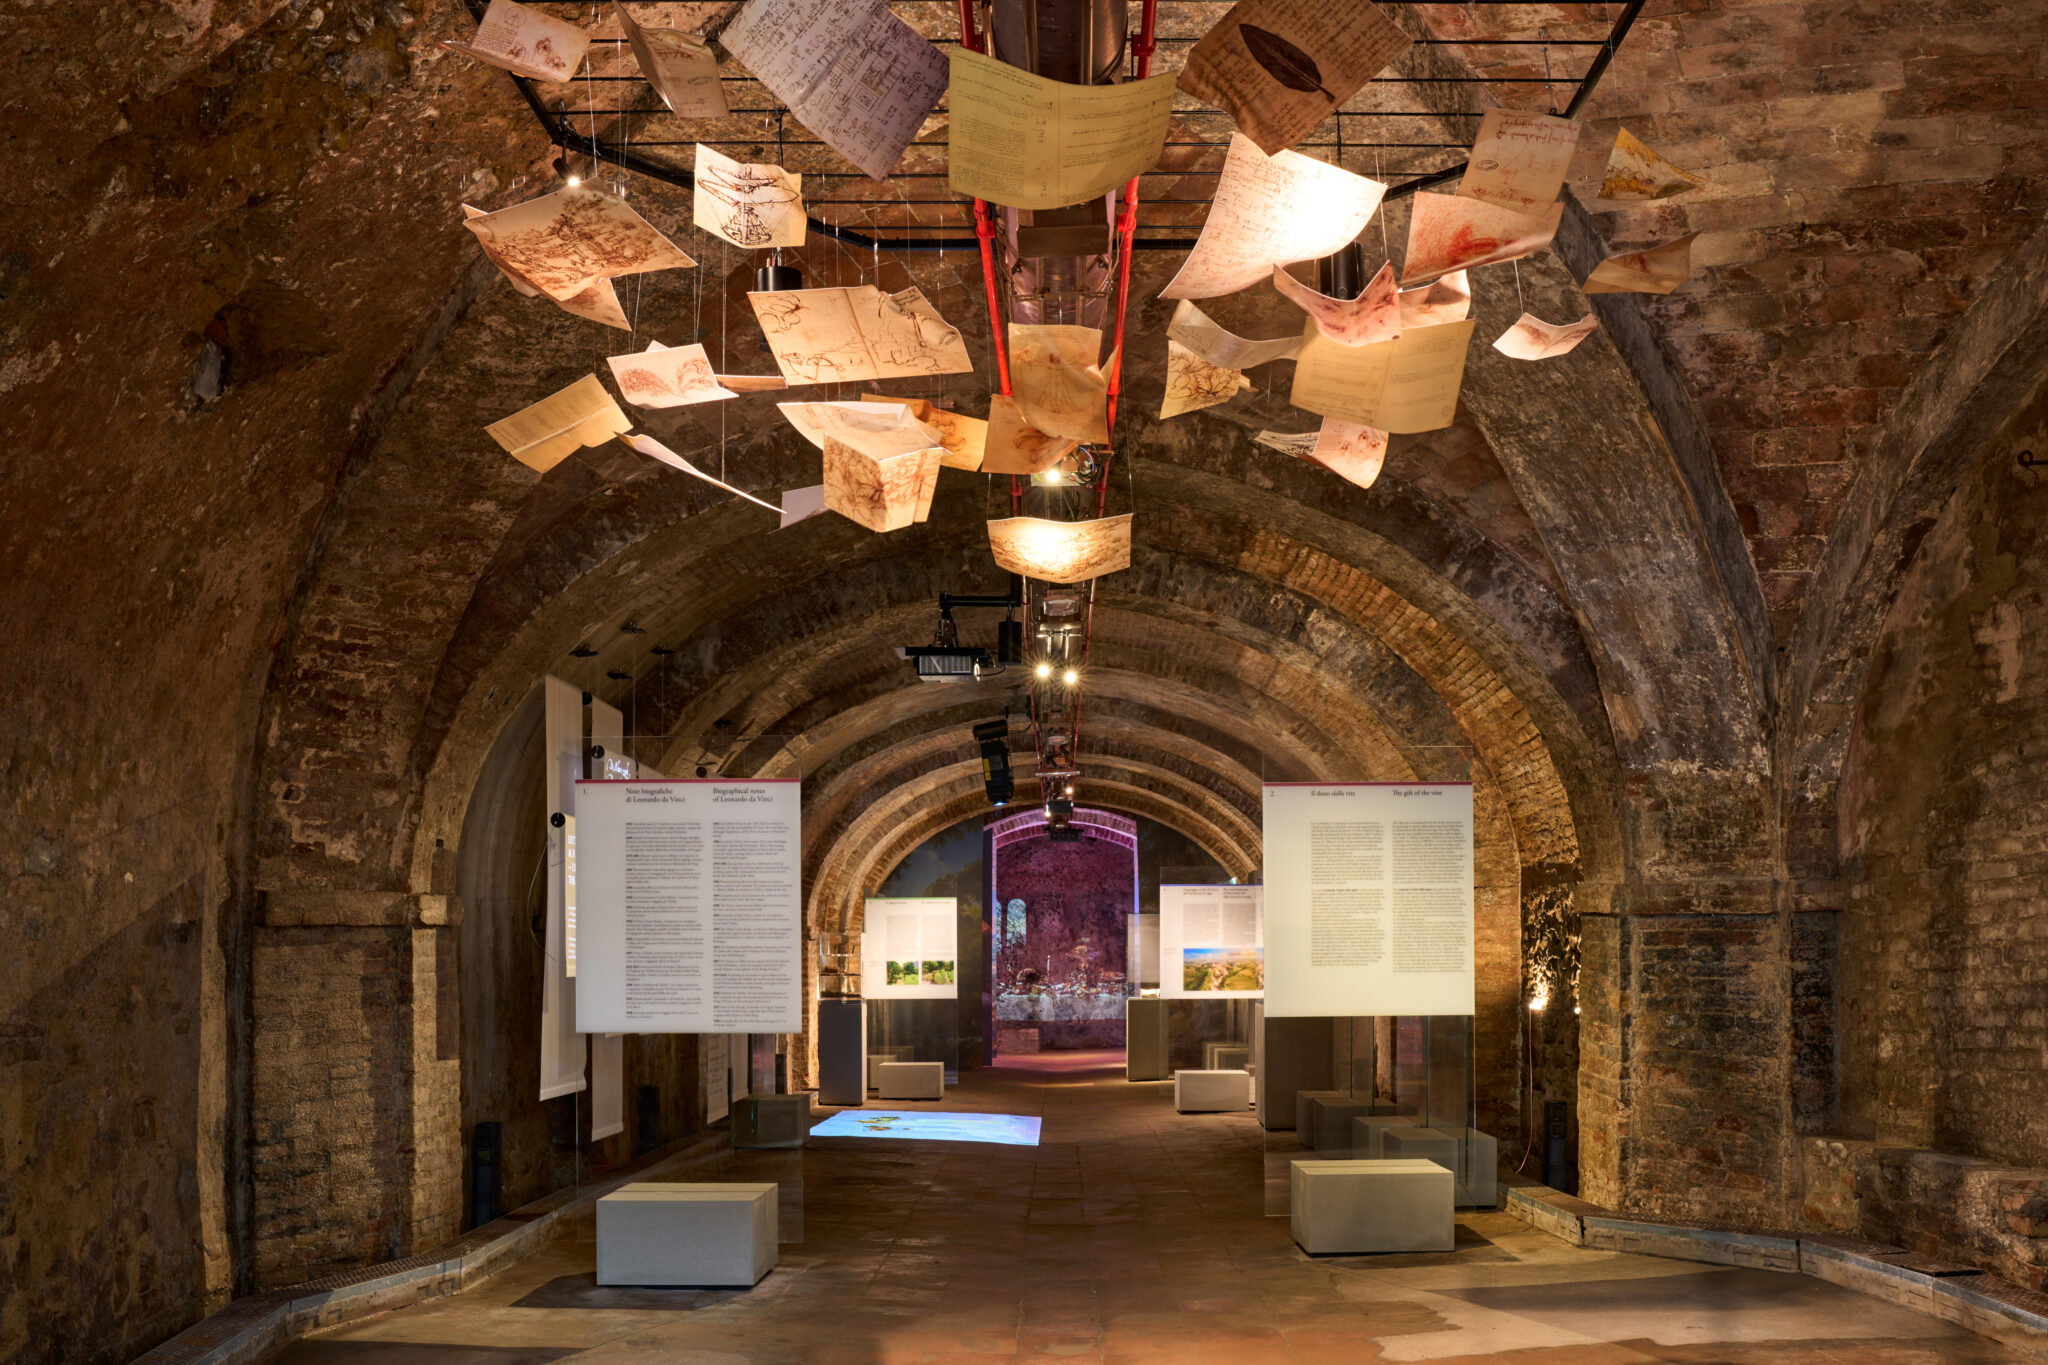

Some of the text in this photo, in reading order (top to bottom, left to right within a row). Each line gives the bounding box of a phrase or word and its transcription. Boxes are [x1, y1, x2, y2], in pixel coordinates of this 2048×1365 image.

[641, 787, 673, 796] biografiche
[713, 787, 749, 796] Biographical
[1404, 789, 1413, 798] gift
